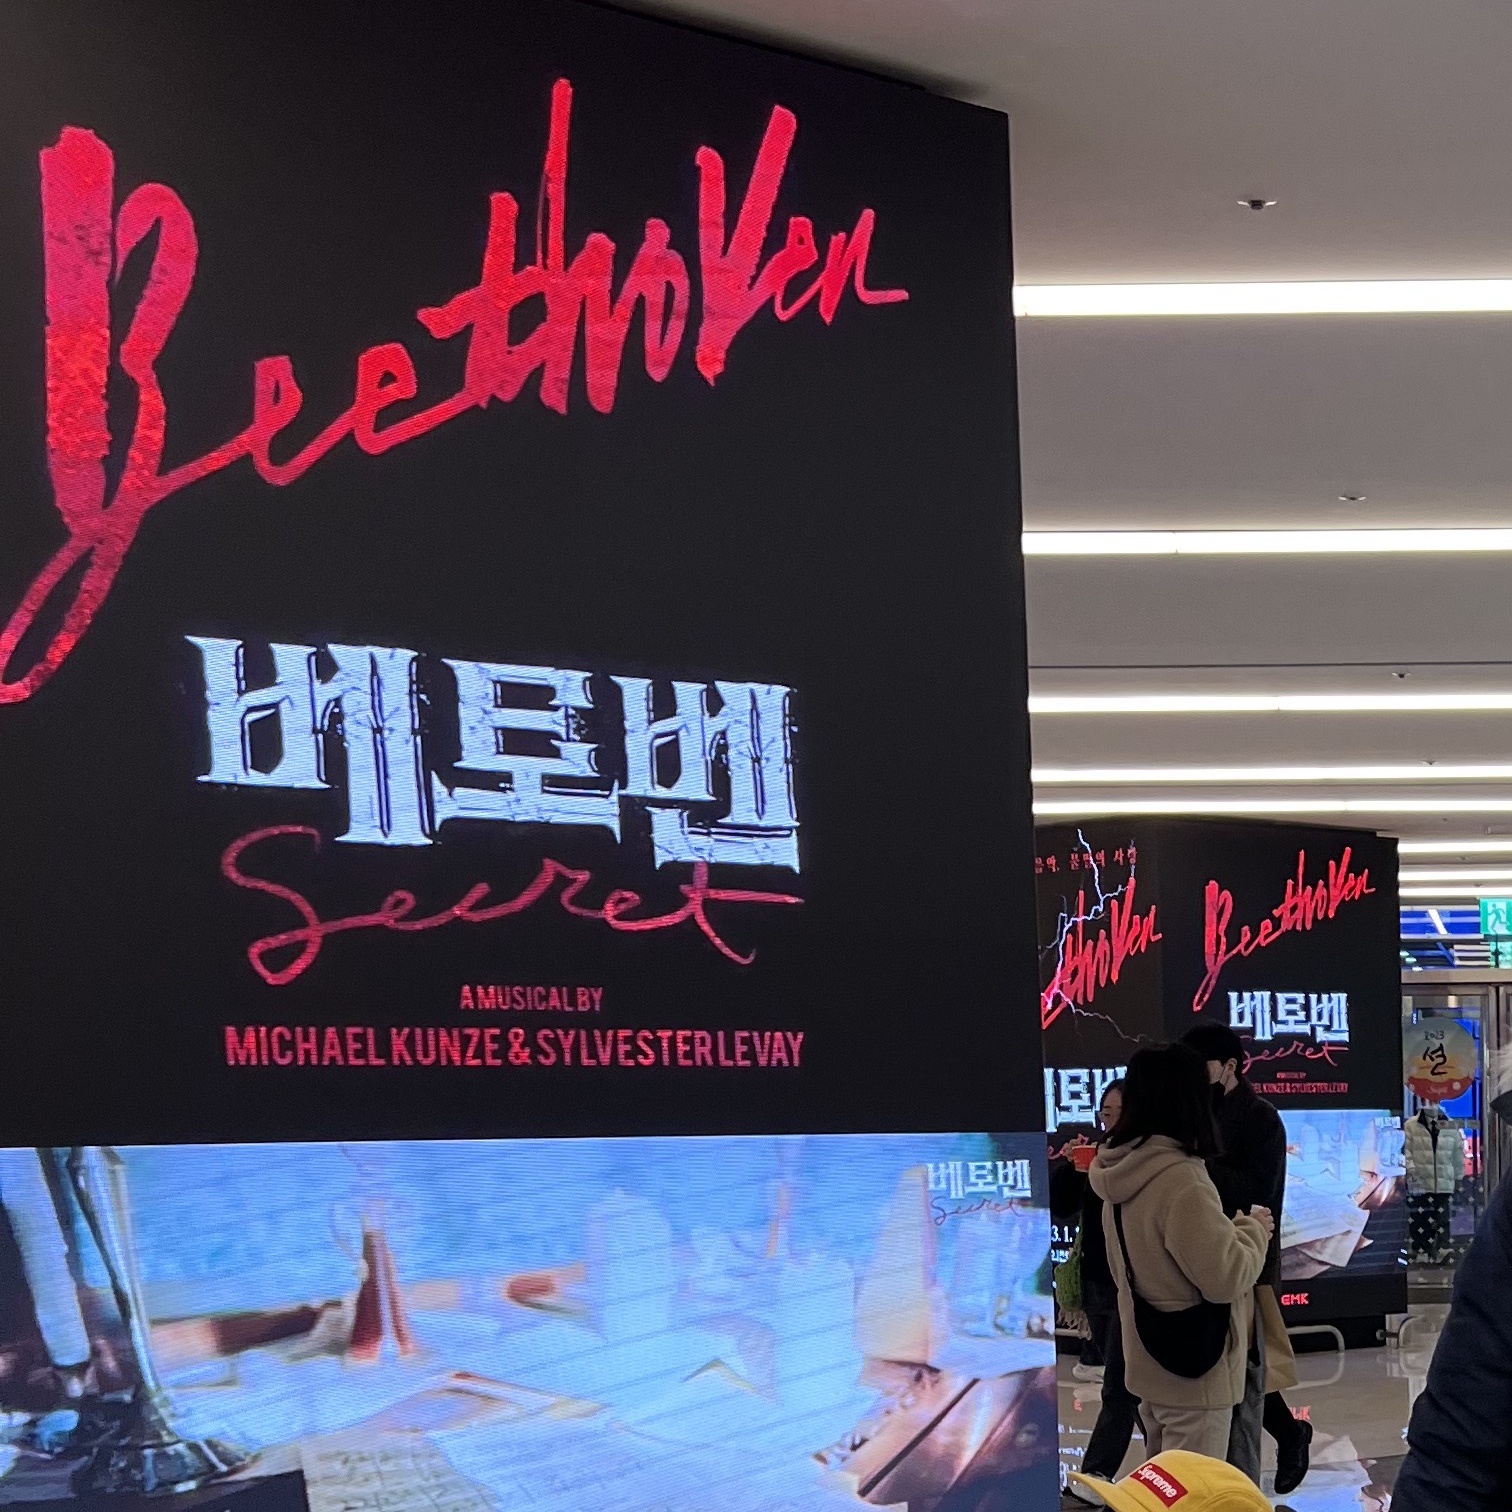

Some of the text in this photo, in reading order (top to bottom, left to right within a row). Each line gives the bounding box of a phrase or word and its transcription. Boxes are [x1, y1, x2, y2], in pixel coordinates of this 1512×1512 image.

[184, 635, 801, 873] 베토벤
[221, 823, 804, 985] Secret
[459, 985, 604, 1011] A MUSICAL BY
[1227, 990, 1350, 1044] 베토벤
[224, 1025, 804, 1068] MICHAEL KUNZE & SYLVESTER LEVAY
[1422, 1043, 1448, 1076] 설
[926, 1159, 1031, 1199] 베토벤
[1281, 1292, 1309, 1306] EMK
[1137, 1464, 1178, 1499] Supreme
